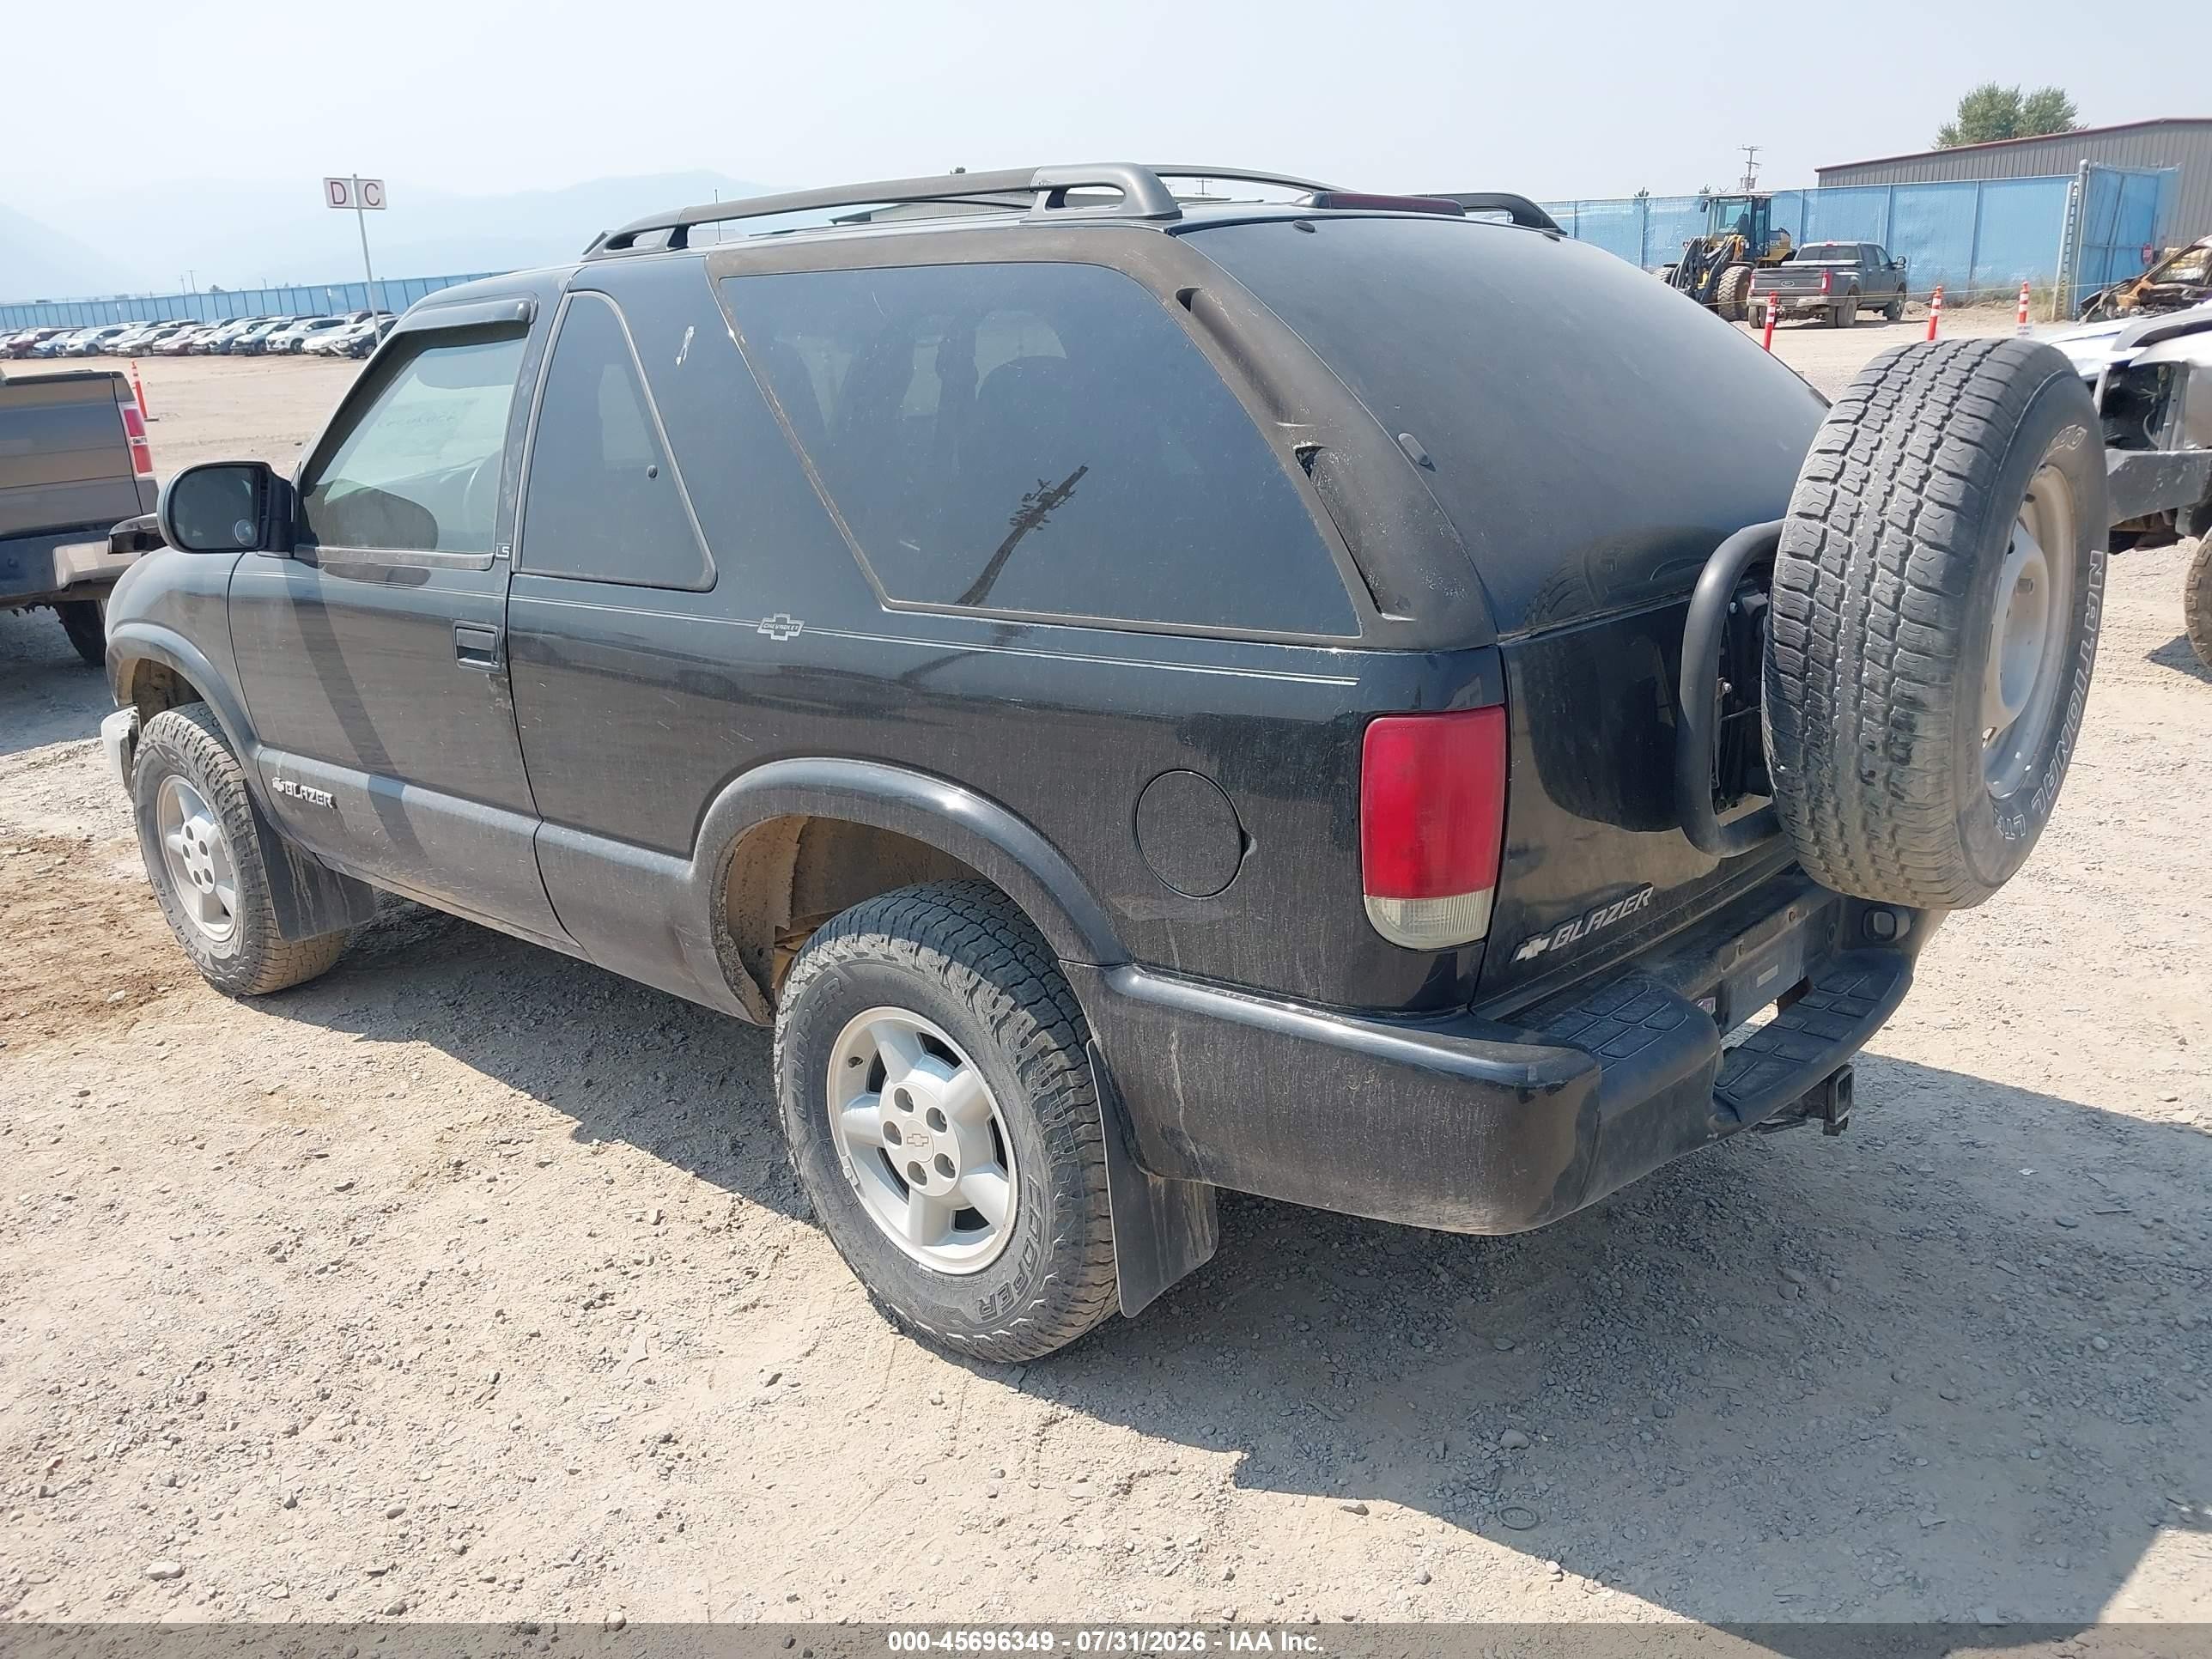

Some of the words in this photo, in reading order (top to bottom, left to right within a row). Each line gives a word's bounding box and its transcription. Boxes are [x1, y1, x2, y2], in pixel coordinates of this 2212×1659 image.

[330, 180, 347, 205] D
[364, 182, 381, 207] C
[495, 545, 510, 558] LS
[2031, 550, 2105, 815] NATIONAL
[284, 780, 334, 809] BLAZER
[1549, 886, 1655, 951] BLAZER
[977, 1174, 1044, 1322] COOPER
